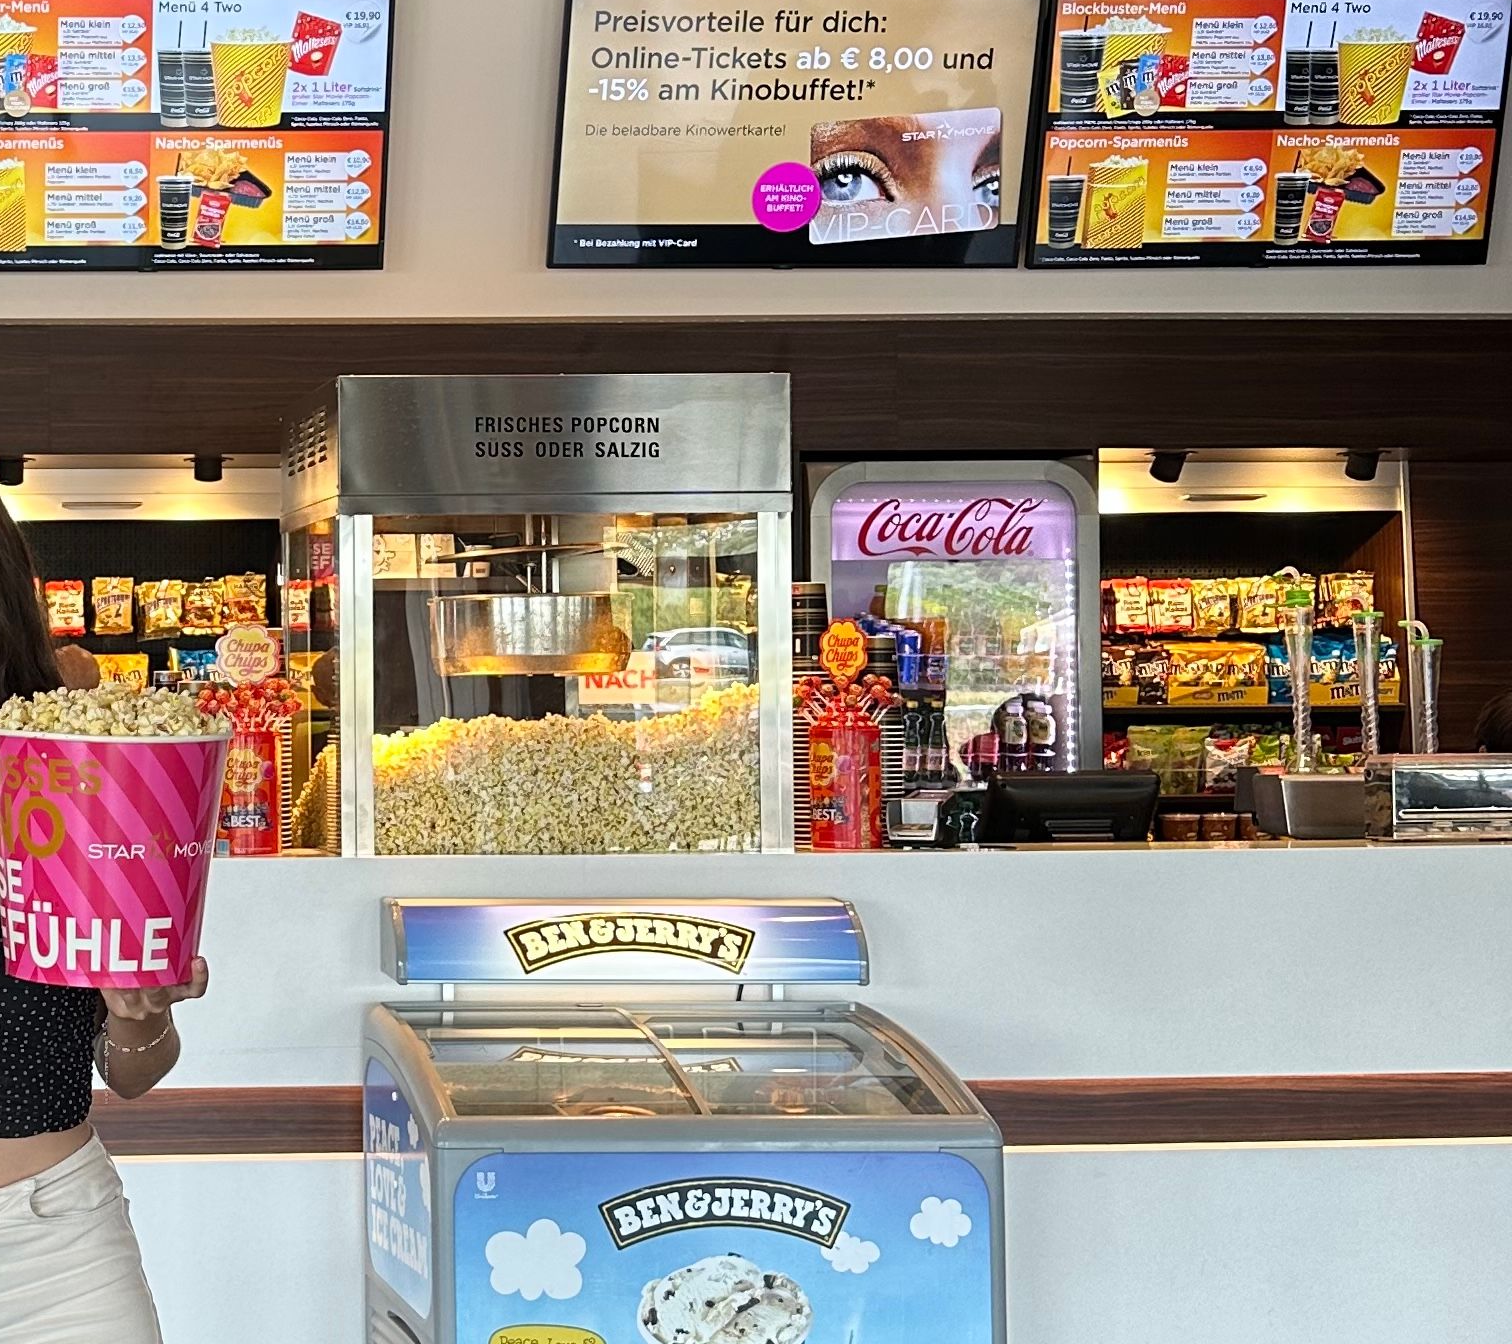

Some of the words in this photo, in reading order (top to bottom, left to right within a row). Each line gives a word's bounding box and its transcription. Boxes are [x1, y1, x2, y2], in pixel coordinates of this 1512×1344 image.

[159, 1, 196, 13] Menü
[201, 2, 208, 12] 4
[214, 2, 242, 13] Two
[1063, 3, 1186, 15] Blockbuster-Menü
[1291, 2, 1327, 14] Menü
[1332, 3, 1339, 13] 4
[1345, 3, 1370, 13] Two
[346, 11, 352, 20] €
[594, 10, 764, 32] Preisvorteile
[775, 10, 813, 33] für
[822, 10, 887, 33] dich:
[1470, 12, 1476, 20] €
[591, 47, 787, 70] Online-Tickets
[797, 48, 831, 70] ab
[840, 49, 859, 70] €
[869, 48, 933, 73] 8,00
[943, 48, 993, 70] und
[293, 82, 307, 92] 2x
[324, 82, 353, 92] Liter
[588, 79, 648, 101] -15%
[659, 84, 699, 101] am
[1413, 80, 1427, 90] 2x
[1443, 80, 1471, 90] Liter
[585, 124, 607, 137] Die
[613, 124, 681, 137] beladbare
[901, 130, 936, 141] STAR
[954, 126, 993, 137] MOVIE
[156, 136, 283, 150] Nacho-Sparmenüs
[1050, 136, 1188, 150] Popcorn-Sparmenüs
[1277, 134, 1400, 147] Nacho-Sparmenüs
[810, 202, 993, 241] VIP-CARD
[475, 417, 563, 433] FRISCHES
[571, 417, 660, 433] POPCORN
[475, 439, 523, 458] SÜSS
[535, 441, 584, 458] ODER
[595, 441, 660, 458] SALZIG
[227, 639, 270, 654] Chupa
[828, 636, 860, 650] Chupa
[224, 654, 268, 676] Chups
[826, 650, 858, 669] Chups
[231, 815, 260, 827] BEST
[88, 844, 146, 860] STAR
